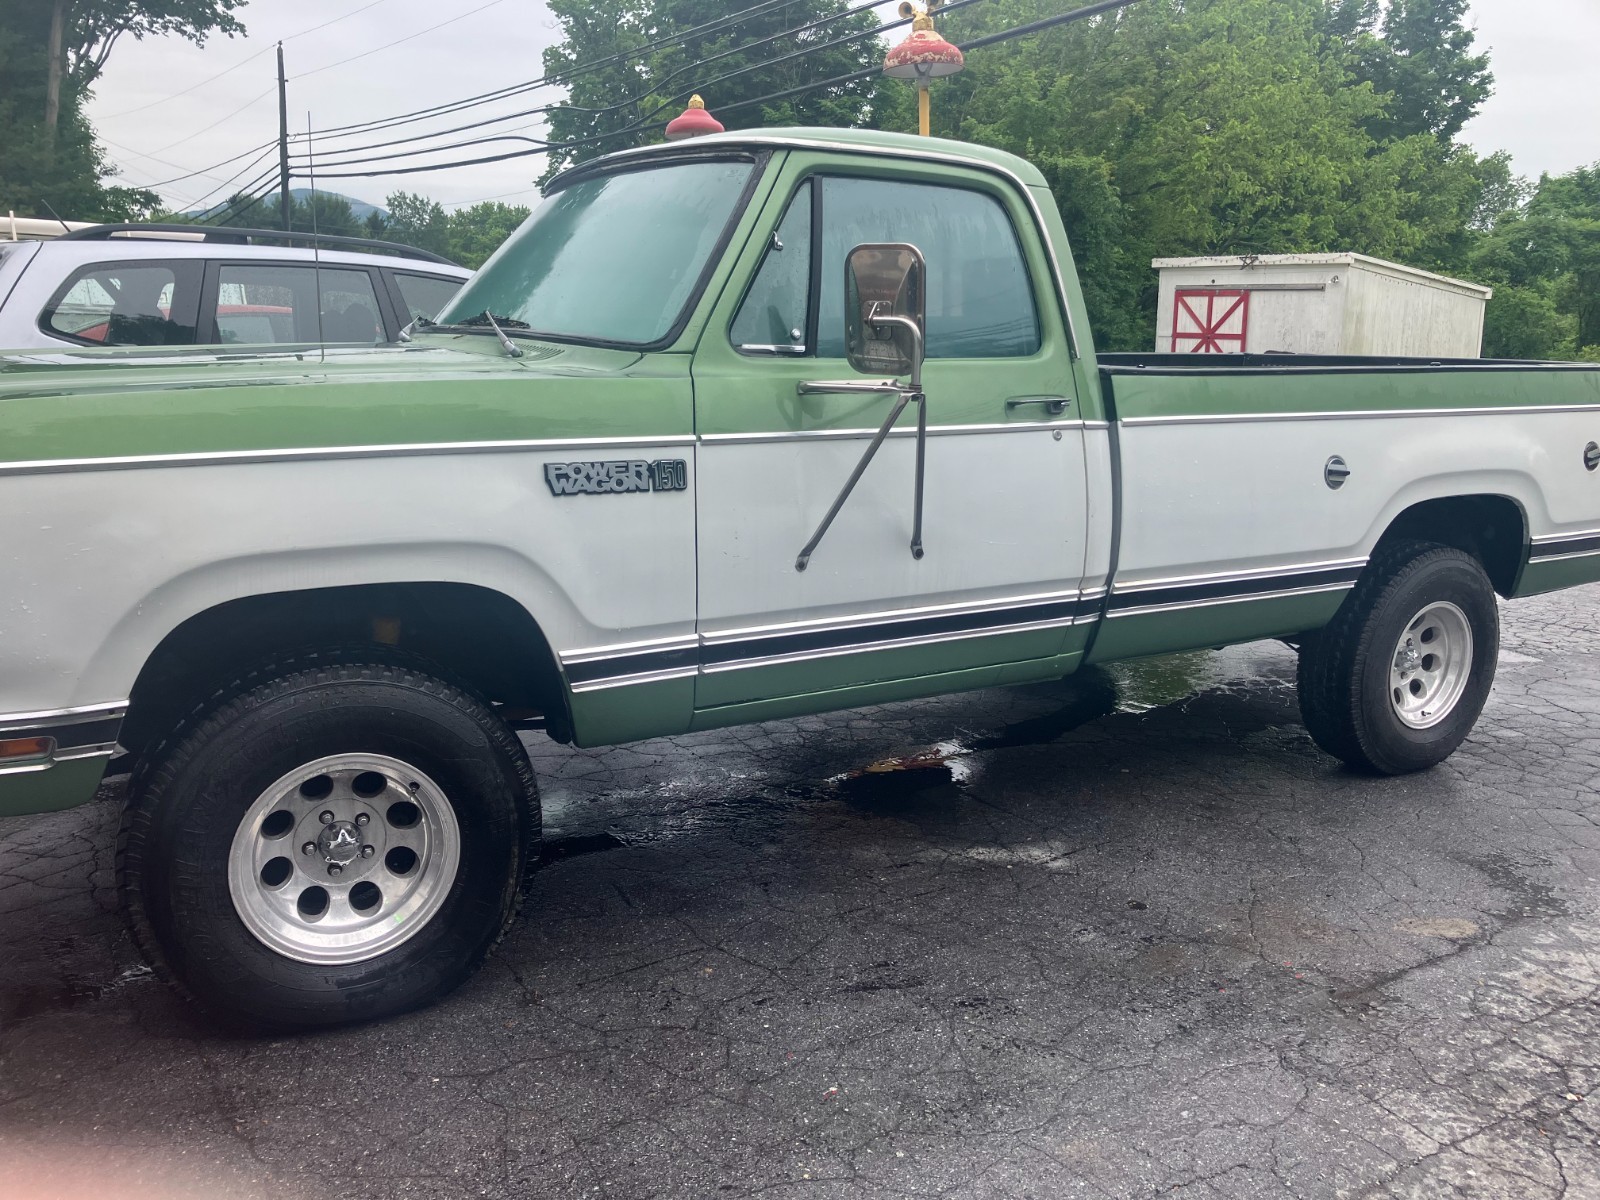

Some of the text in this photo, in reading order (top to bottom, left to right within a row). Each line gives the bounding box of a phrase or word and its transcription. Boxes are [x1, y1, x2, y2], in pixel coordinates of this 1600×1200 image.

[545, 461, 649, 478] POWER
[652, 460, 687, 490] 150
[548, 475, 649, 496] WAGON
